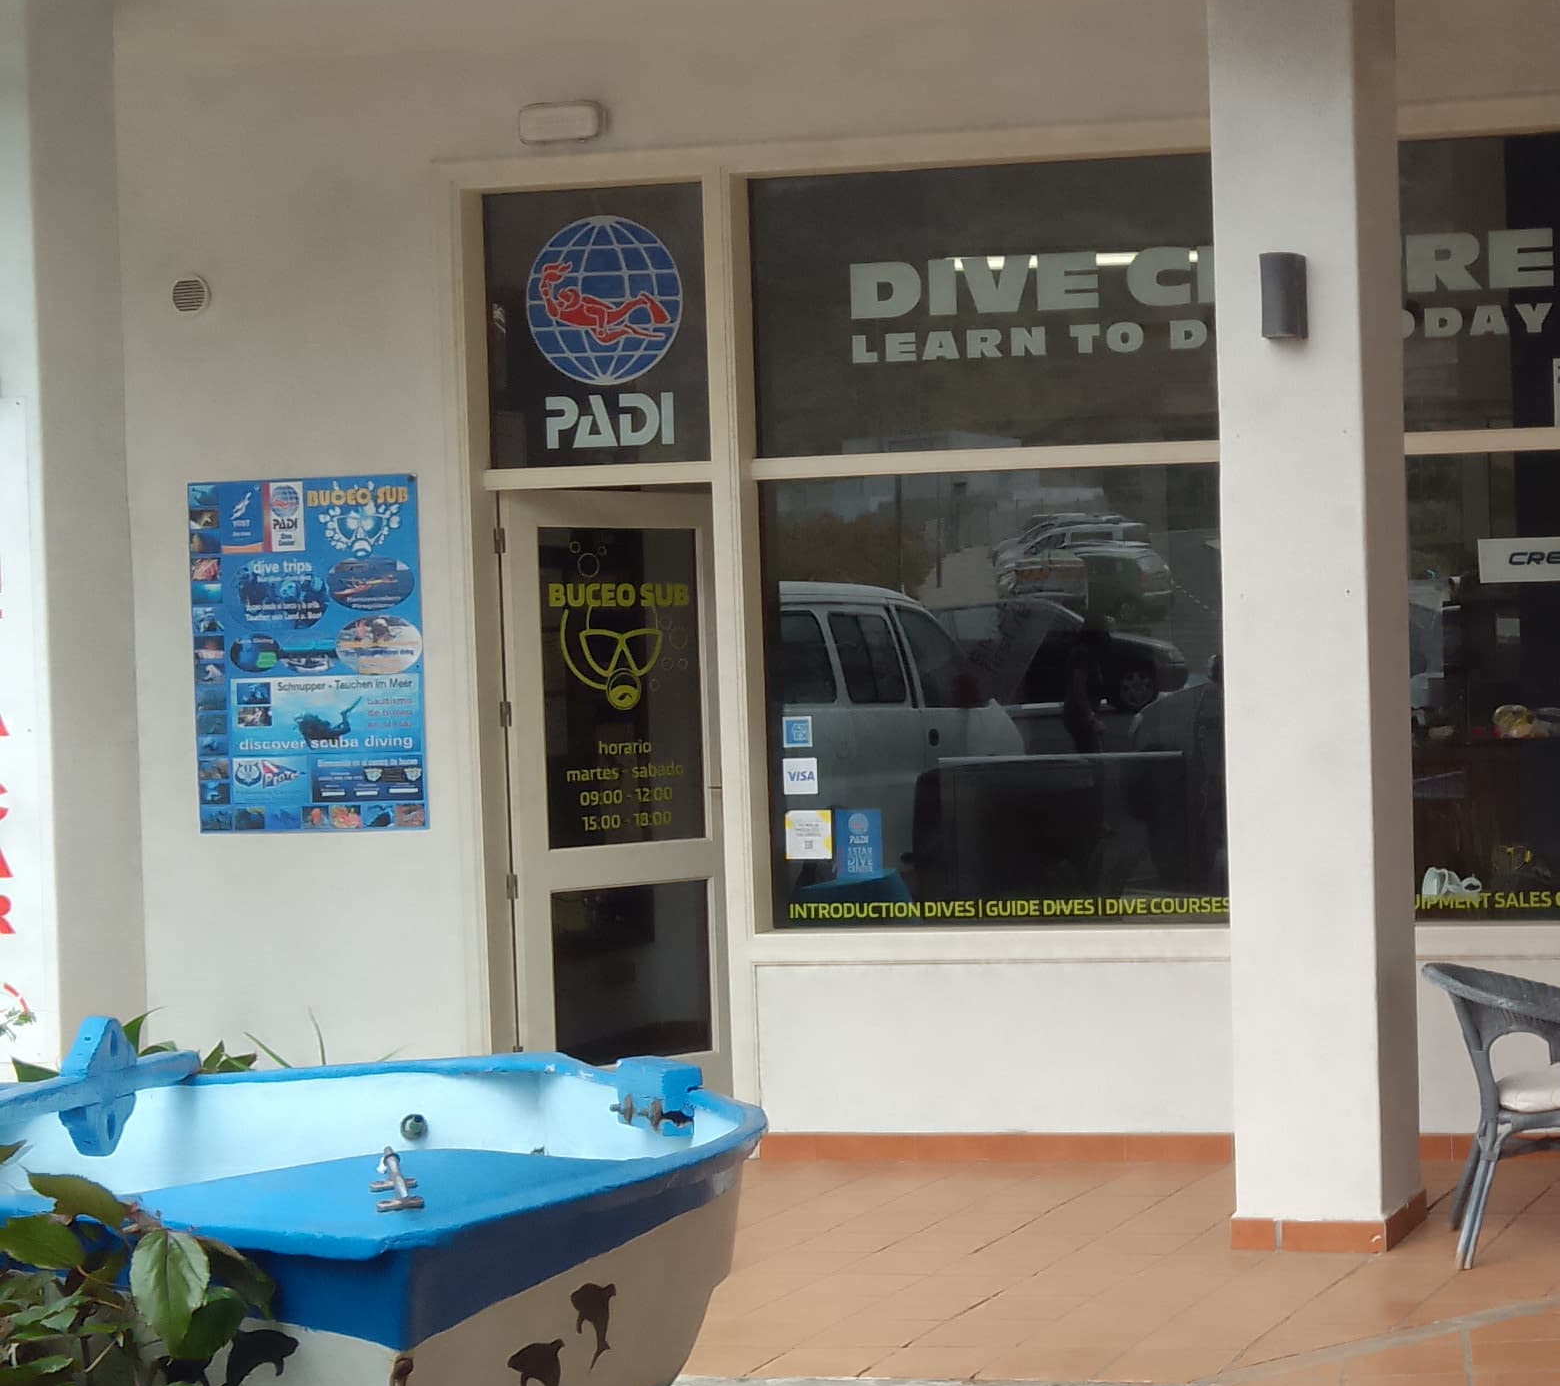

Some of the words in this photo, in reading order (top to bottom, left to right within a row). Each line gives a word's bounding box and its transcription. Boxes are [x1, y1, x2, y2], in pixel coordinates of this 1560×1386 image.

[849, 251, 1100, 320] DIVE
[852, 326, 1047, 363] LEARN
[1069, 321, 1144, 353] TO
[545, 392, 675, 449] PADI
[307, 489, 370, 507] BUCEO
[376, 486, 408, 503] SUB
[272, 518, 298, 530] PADI
[253, 560, 280, 576] dive
[283, 559, 312, 574] trips
[549, 583, 636, 607] BUCEO
[639, 582, 689, 607] SUB
[277, 682, 325, 692] Schnupper
[335, 679, 373, 690] Tauchen
[375, 678, 387, 688] im
[389, 678, 413, 688] Meer
[239, 737, 305, 751] discover
[310, 736, 359, 750] scuba
[364, 734, 413, 750] diving
[598, 739, 651, 755] horario
[566, 767, 620, 782] martes
[787, 771, 815, 781] VISA
[580, 790, 622, 806] 09:00
[635, 787, 673, 803] 12:00
[581, 815, 621, 831] 15:00
[789, 901, 920, 919] INTRODUCTION
[925, 900, 975, 918] DIVES
[986, 900, 1039, 917] GUIDE
[1043, 899, 1094, 916] DIVES
[1106, 898, 1147, 915] DIVE
[1150, 896, 1230, 914] COURSES
[1494, 890, 1552, 909] SALES
